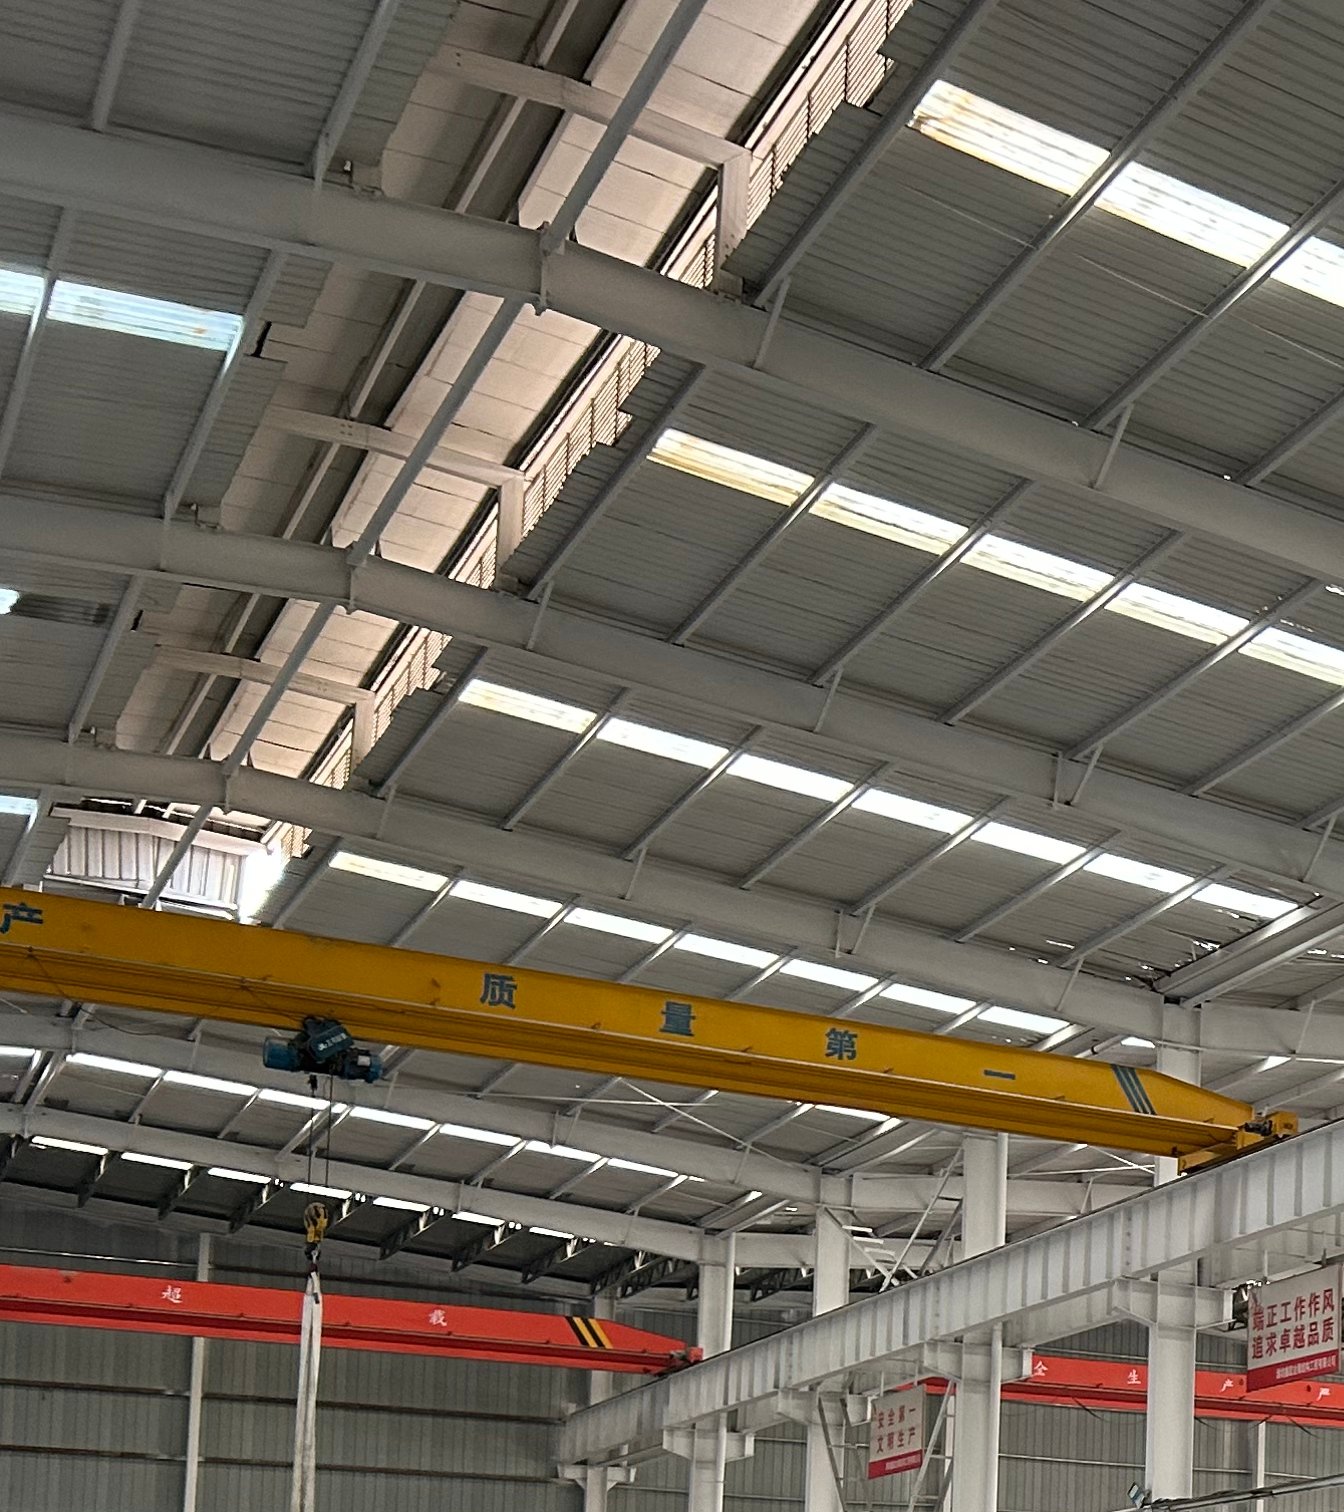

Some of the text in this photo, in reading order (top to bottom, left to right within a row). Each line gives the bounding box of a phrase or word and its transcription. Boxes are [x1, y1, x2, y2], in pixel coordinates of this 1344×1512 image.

[1253, 1288, 1335, 1331] 端正工作作风
[1252, 1316, 1335, 1359] 追求卓越品质
